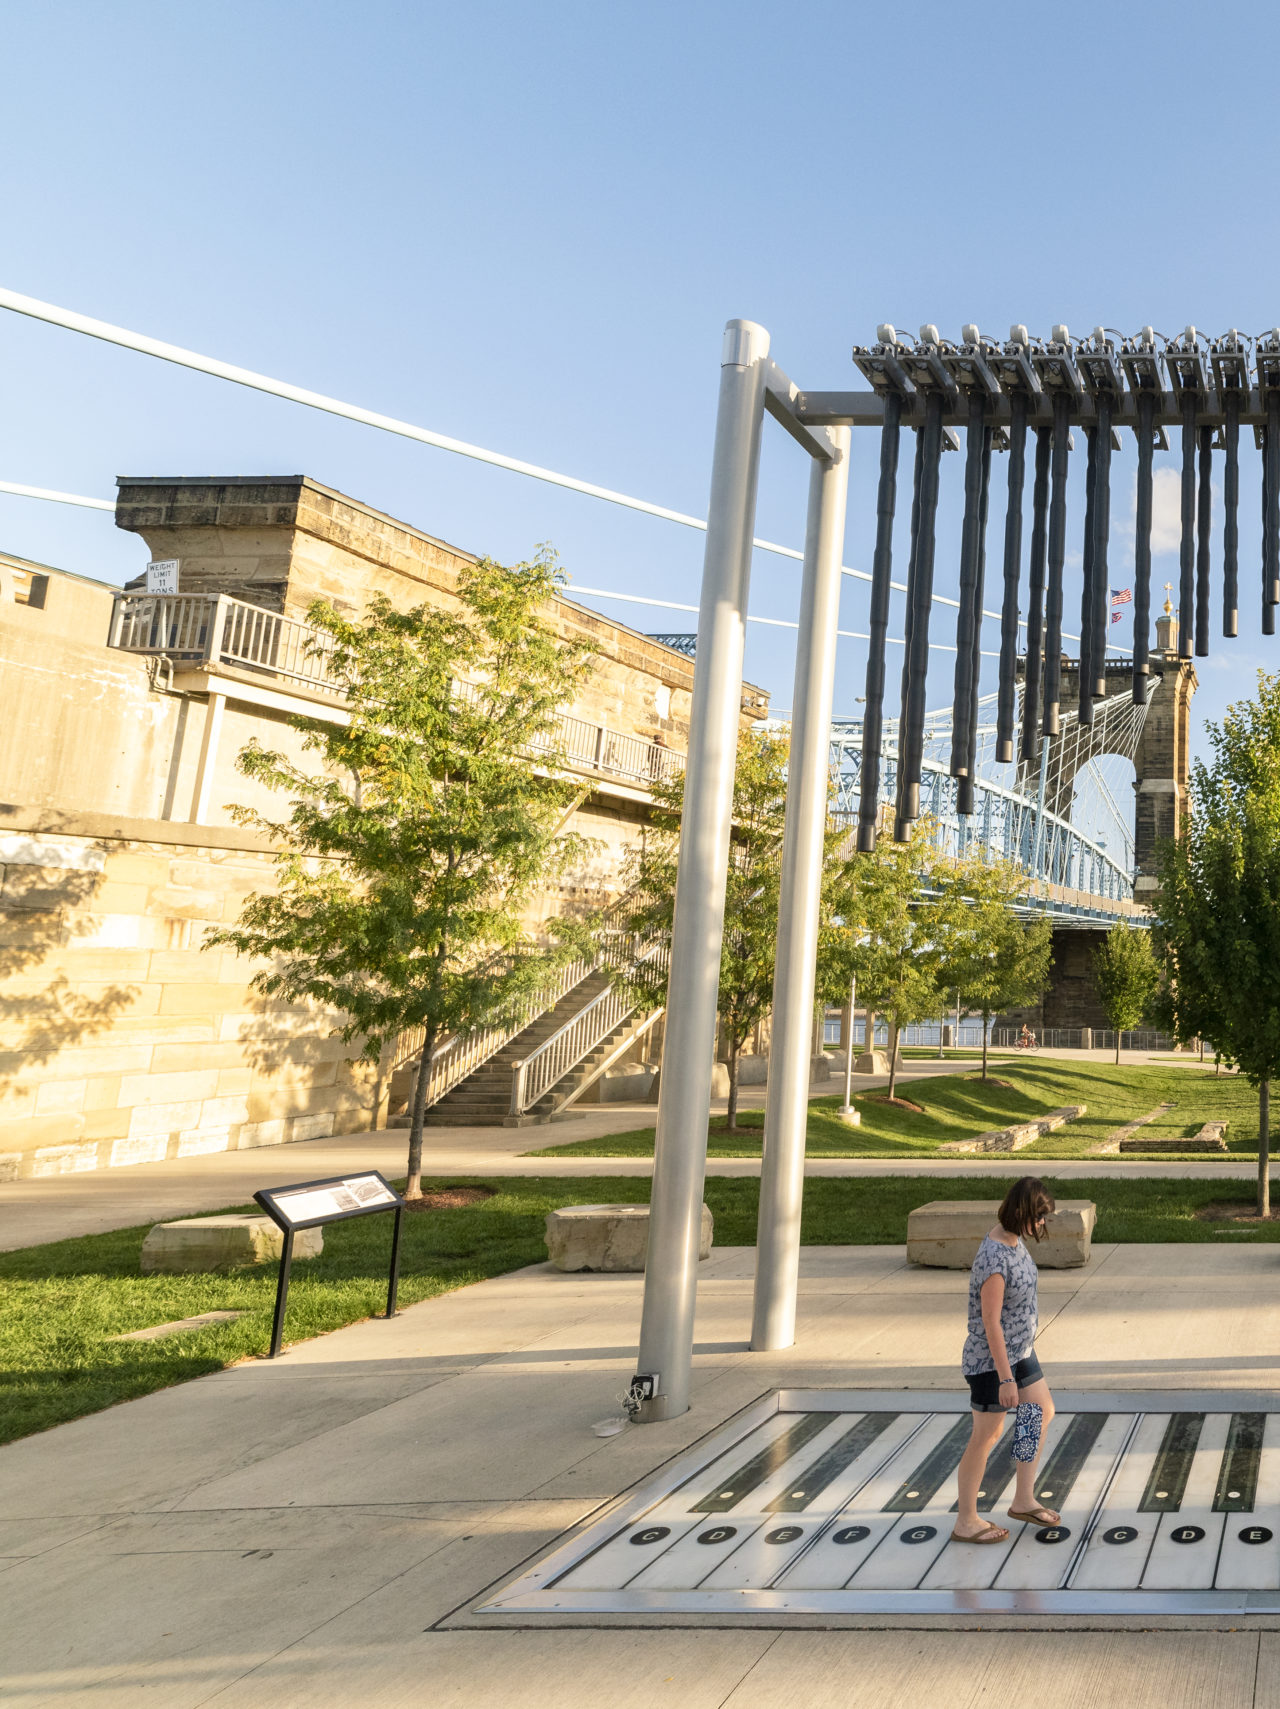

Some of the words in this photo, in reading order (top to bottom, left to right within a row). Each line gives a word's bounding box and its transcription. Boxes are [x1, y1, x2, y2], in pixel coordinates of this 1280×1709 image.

[149, 563, 175, 571] WEIGHT
[159, 579, 166, 587] 11
[642, 1532, 660, 1541] C
[708, 1532, 726, 1540] D
[775, 1532, 793, 1540] E
[844, 1531, 860, 1540] F
[911, 1531, 927, 1540] G
[1045, 1531, 1061, 1540] B
[1113, 1532, 1128, 1540] C
[1181, 1531, 1196, 1540] D
[1249, 1531, 1262, 1540] E
